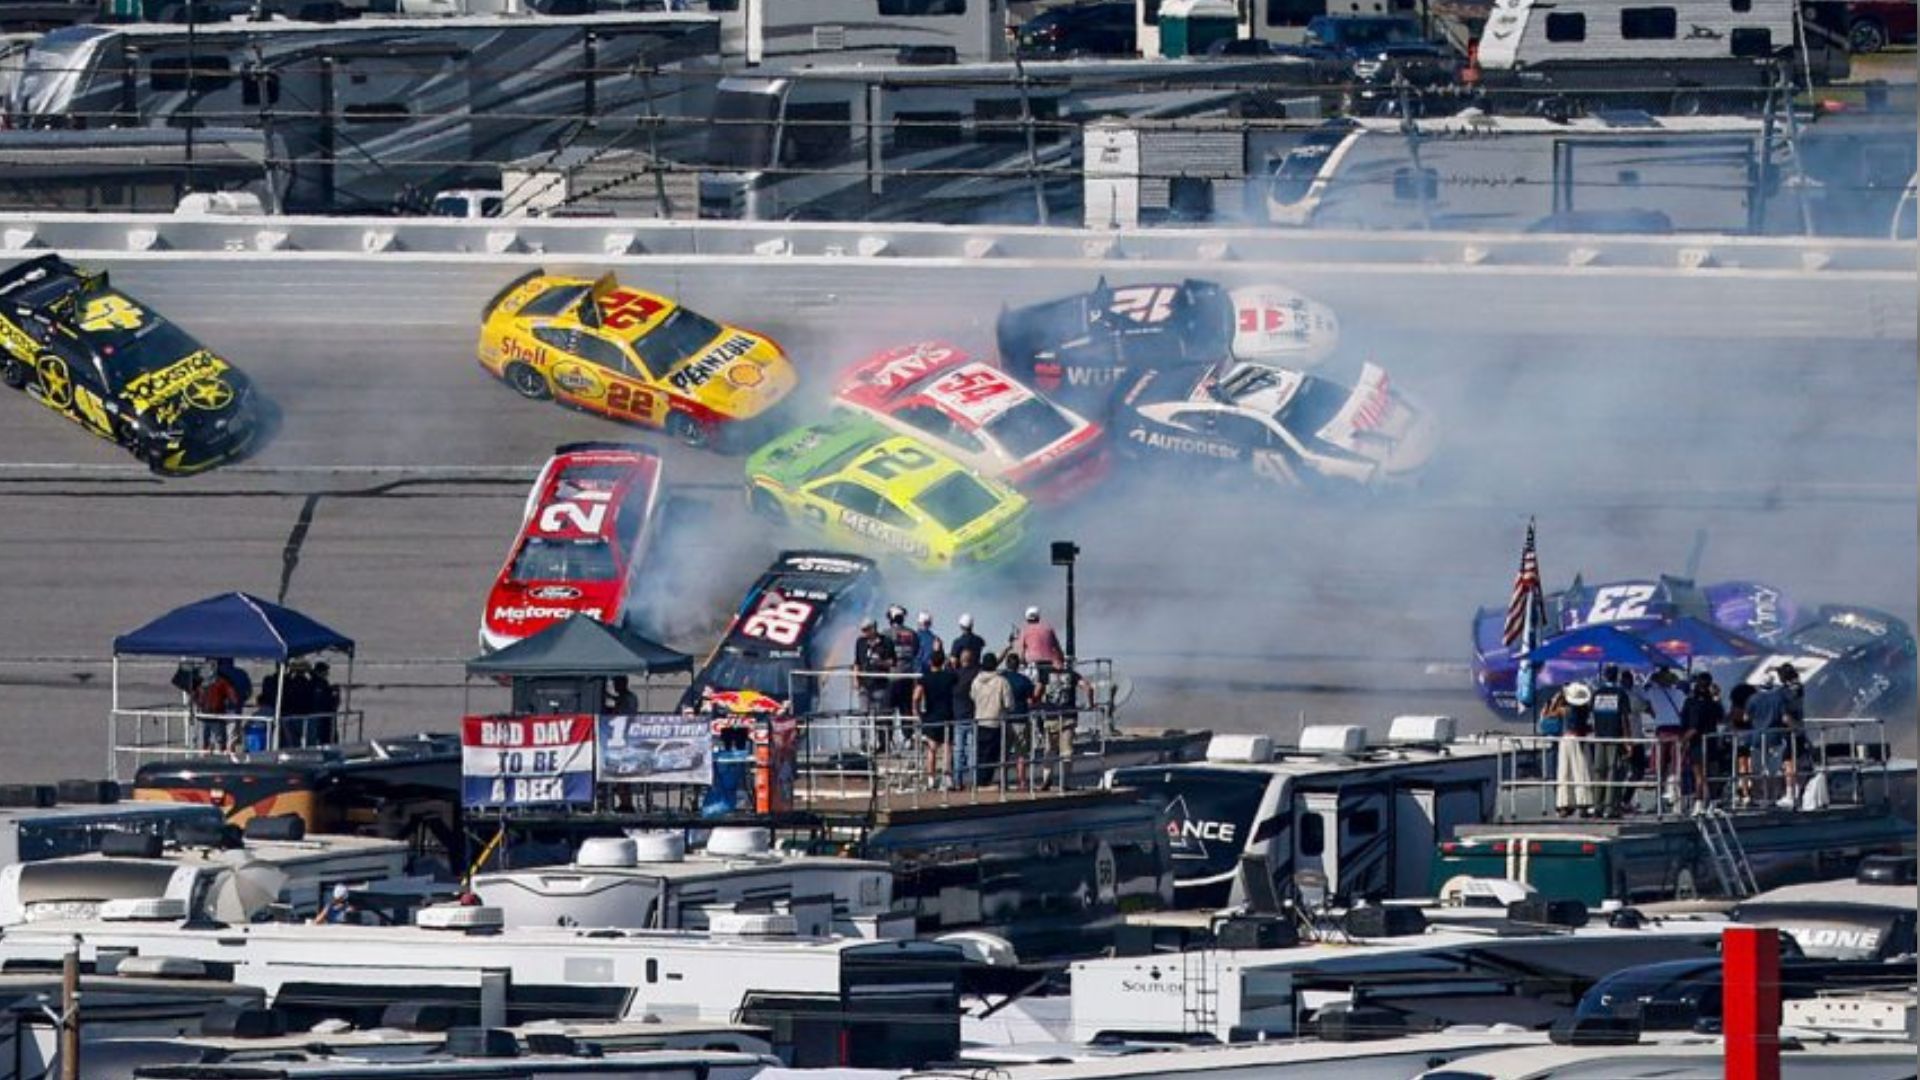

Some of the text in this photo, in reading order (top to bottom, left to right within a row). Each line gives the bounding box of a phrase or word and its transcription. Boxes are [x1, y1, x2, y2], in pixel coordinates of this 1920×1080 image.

[80, 294, 142, 331] 4
[502, 337, 546, 367] Shell
[606, 382, 655, 414] 22
[936, 370, 1011, 403] 54
[1146, 432, 1240, 459] AUTODESK
[859, 448, 936, 479] 2
[494, 606, 602, 622] Motorcft
[481, 719, 574, 745] BAD DAY
[607, 716, 628, 747] 1
[497, 750, 559, 773] TO BE
[490, 778, 505, 803] A
[1167, 819, 1236, 842] ANCE
[1796, 927, 1881, 949] LONE
